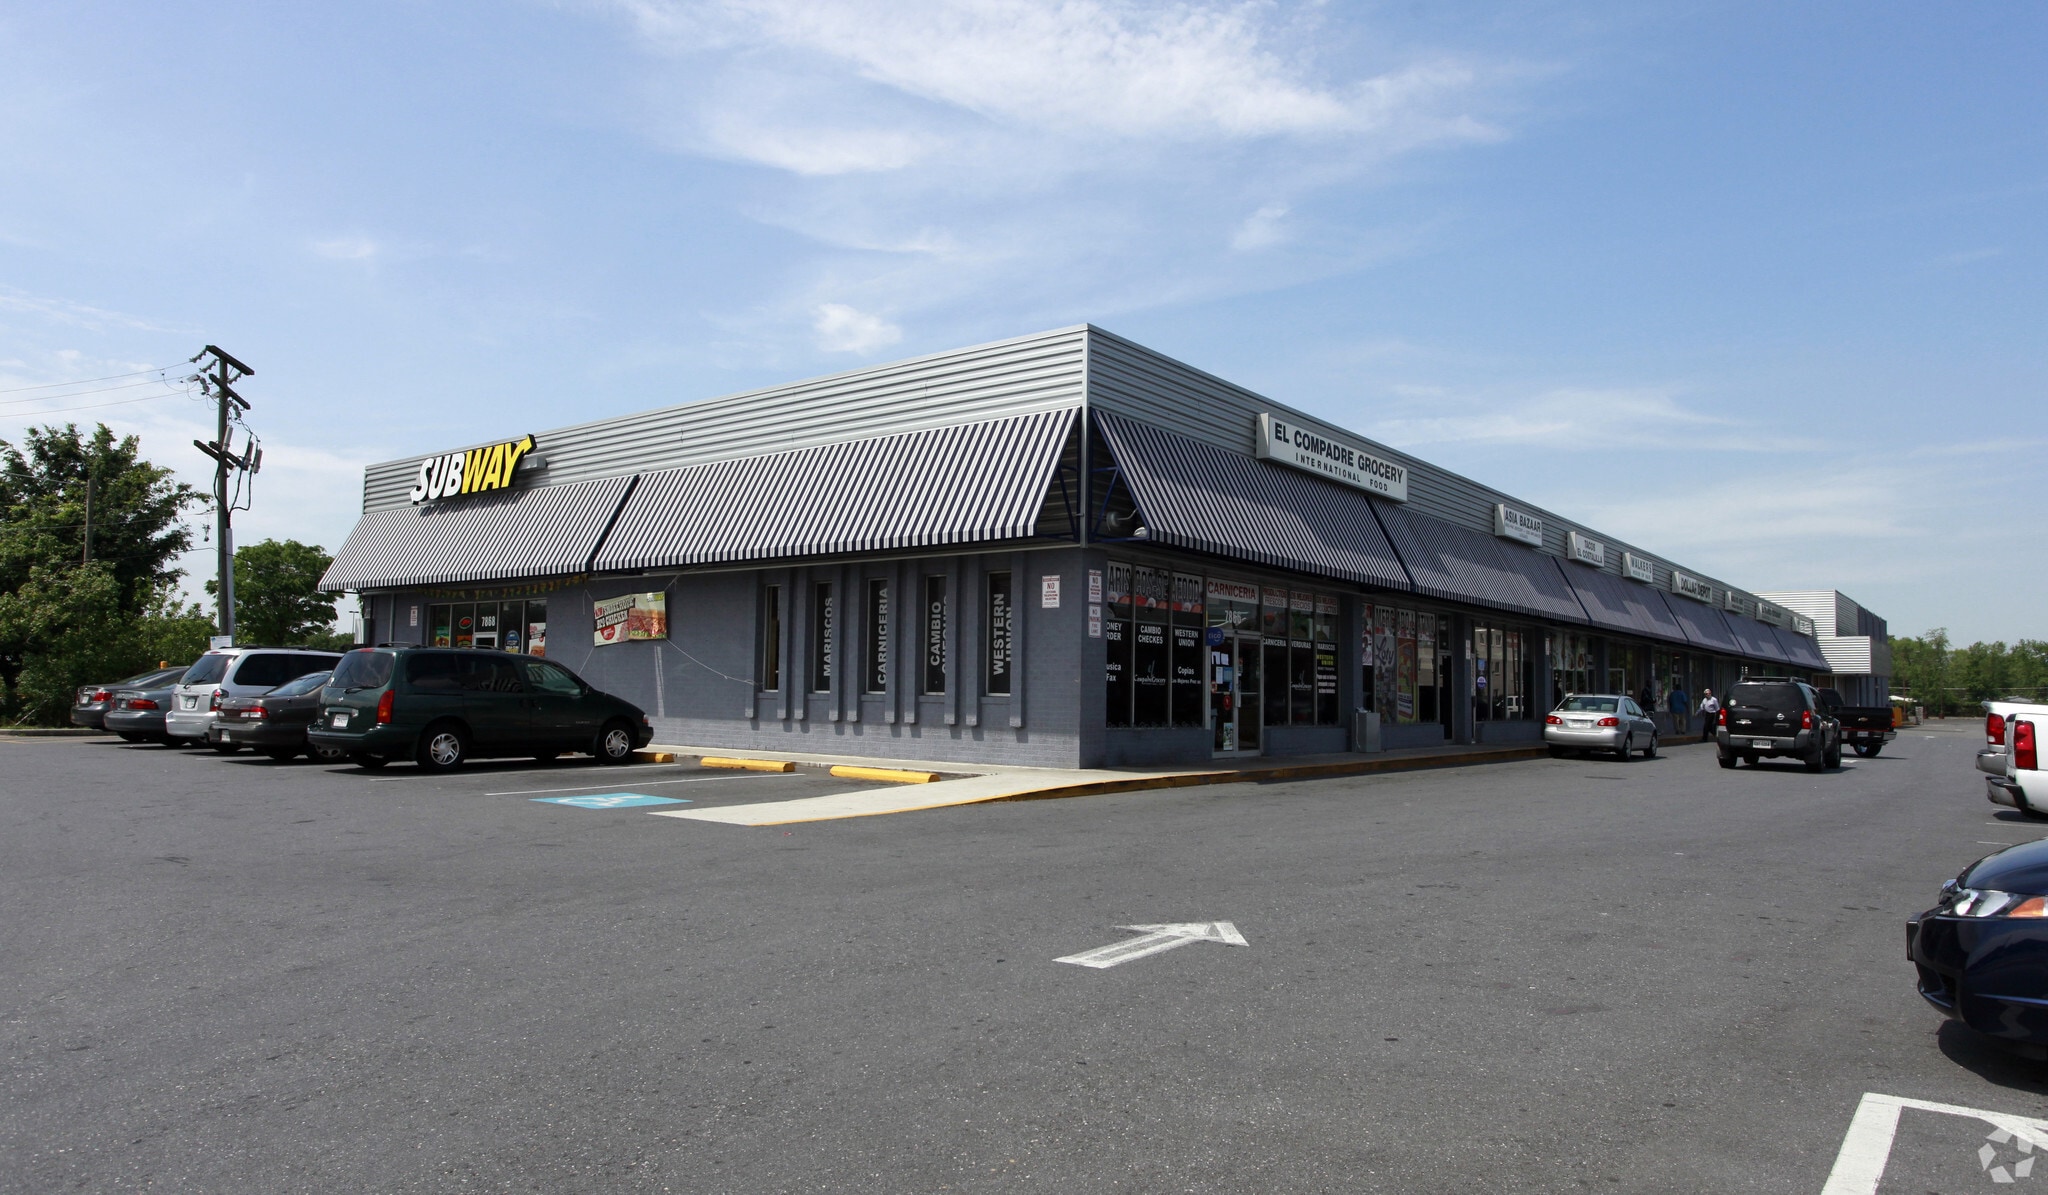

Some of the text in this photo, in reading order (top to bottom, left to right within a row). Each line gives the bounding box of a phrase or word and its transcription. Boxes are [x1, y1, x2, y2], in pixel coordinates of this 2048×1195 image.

[1274, 422, 1404, 484] EL COMPADRE GROCERY
[410, 434, 537, 502] SUBWAY
[1295, 452, 1388, 492] INTERNATIONAL FOOD
[1504, 509, 1518, 525] ASIA
[1519, 515, 1541, 533] BAZAAR
[1207, 581, 1256, 600] CARNICERIA
[930, 601, 942, 666] CAMBIO
[1107, 622, 1122, 631] ONEY
[1140, 625, 1162, 635] CAMBIO
[1174, 628, 1199, 638] WESTERN
[823, 597, 833, 677] MARISCOS
[877, 588, 888, 685] CARNICERIA
[993, 593, 1005, 676] WESTERN
[1107, 631, 1121, 640] RDER
[1138, 634, 1164, 645] CHECKES
[1178, 638, 1195, 647] UNION
[1107, 662, 1121, 671] usica
[1178, 666, 1195, 676] Copias
[1107, 673, 1117, 682] Fax
